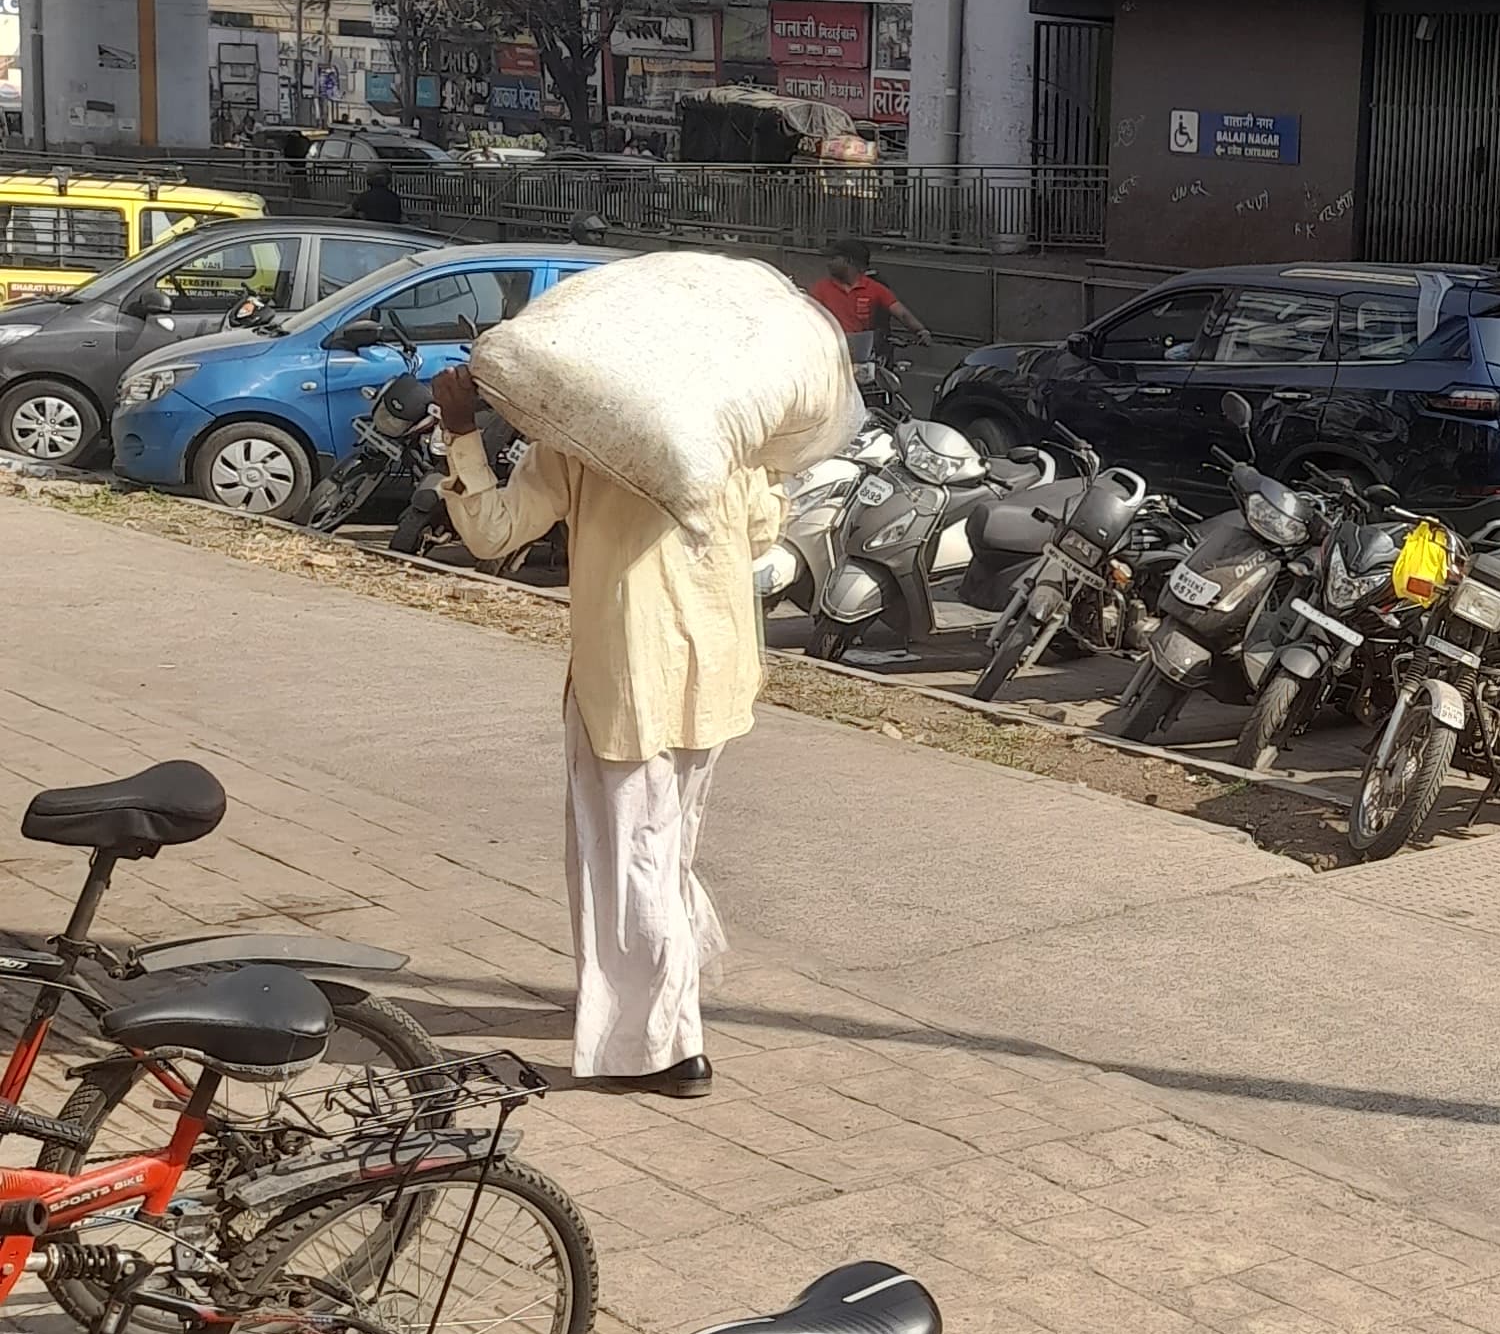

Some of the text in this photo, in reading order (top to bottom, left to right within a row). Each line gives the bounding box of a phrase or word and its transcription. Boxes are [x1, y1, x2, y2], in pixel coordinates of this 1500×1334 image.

[773, 15, 816, 38] बालाजी
[785, 73, 826, 98] बालाजी
[1223, 112, 1275, 130] बालाजी नगर
[1216, 130, 1280, 147] BALAJI NAGAR
[50, 1173, 146, 1213] SPORTS BIKE
